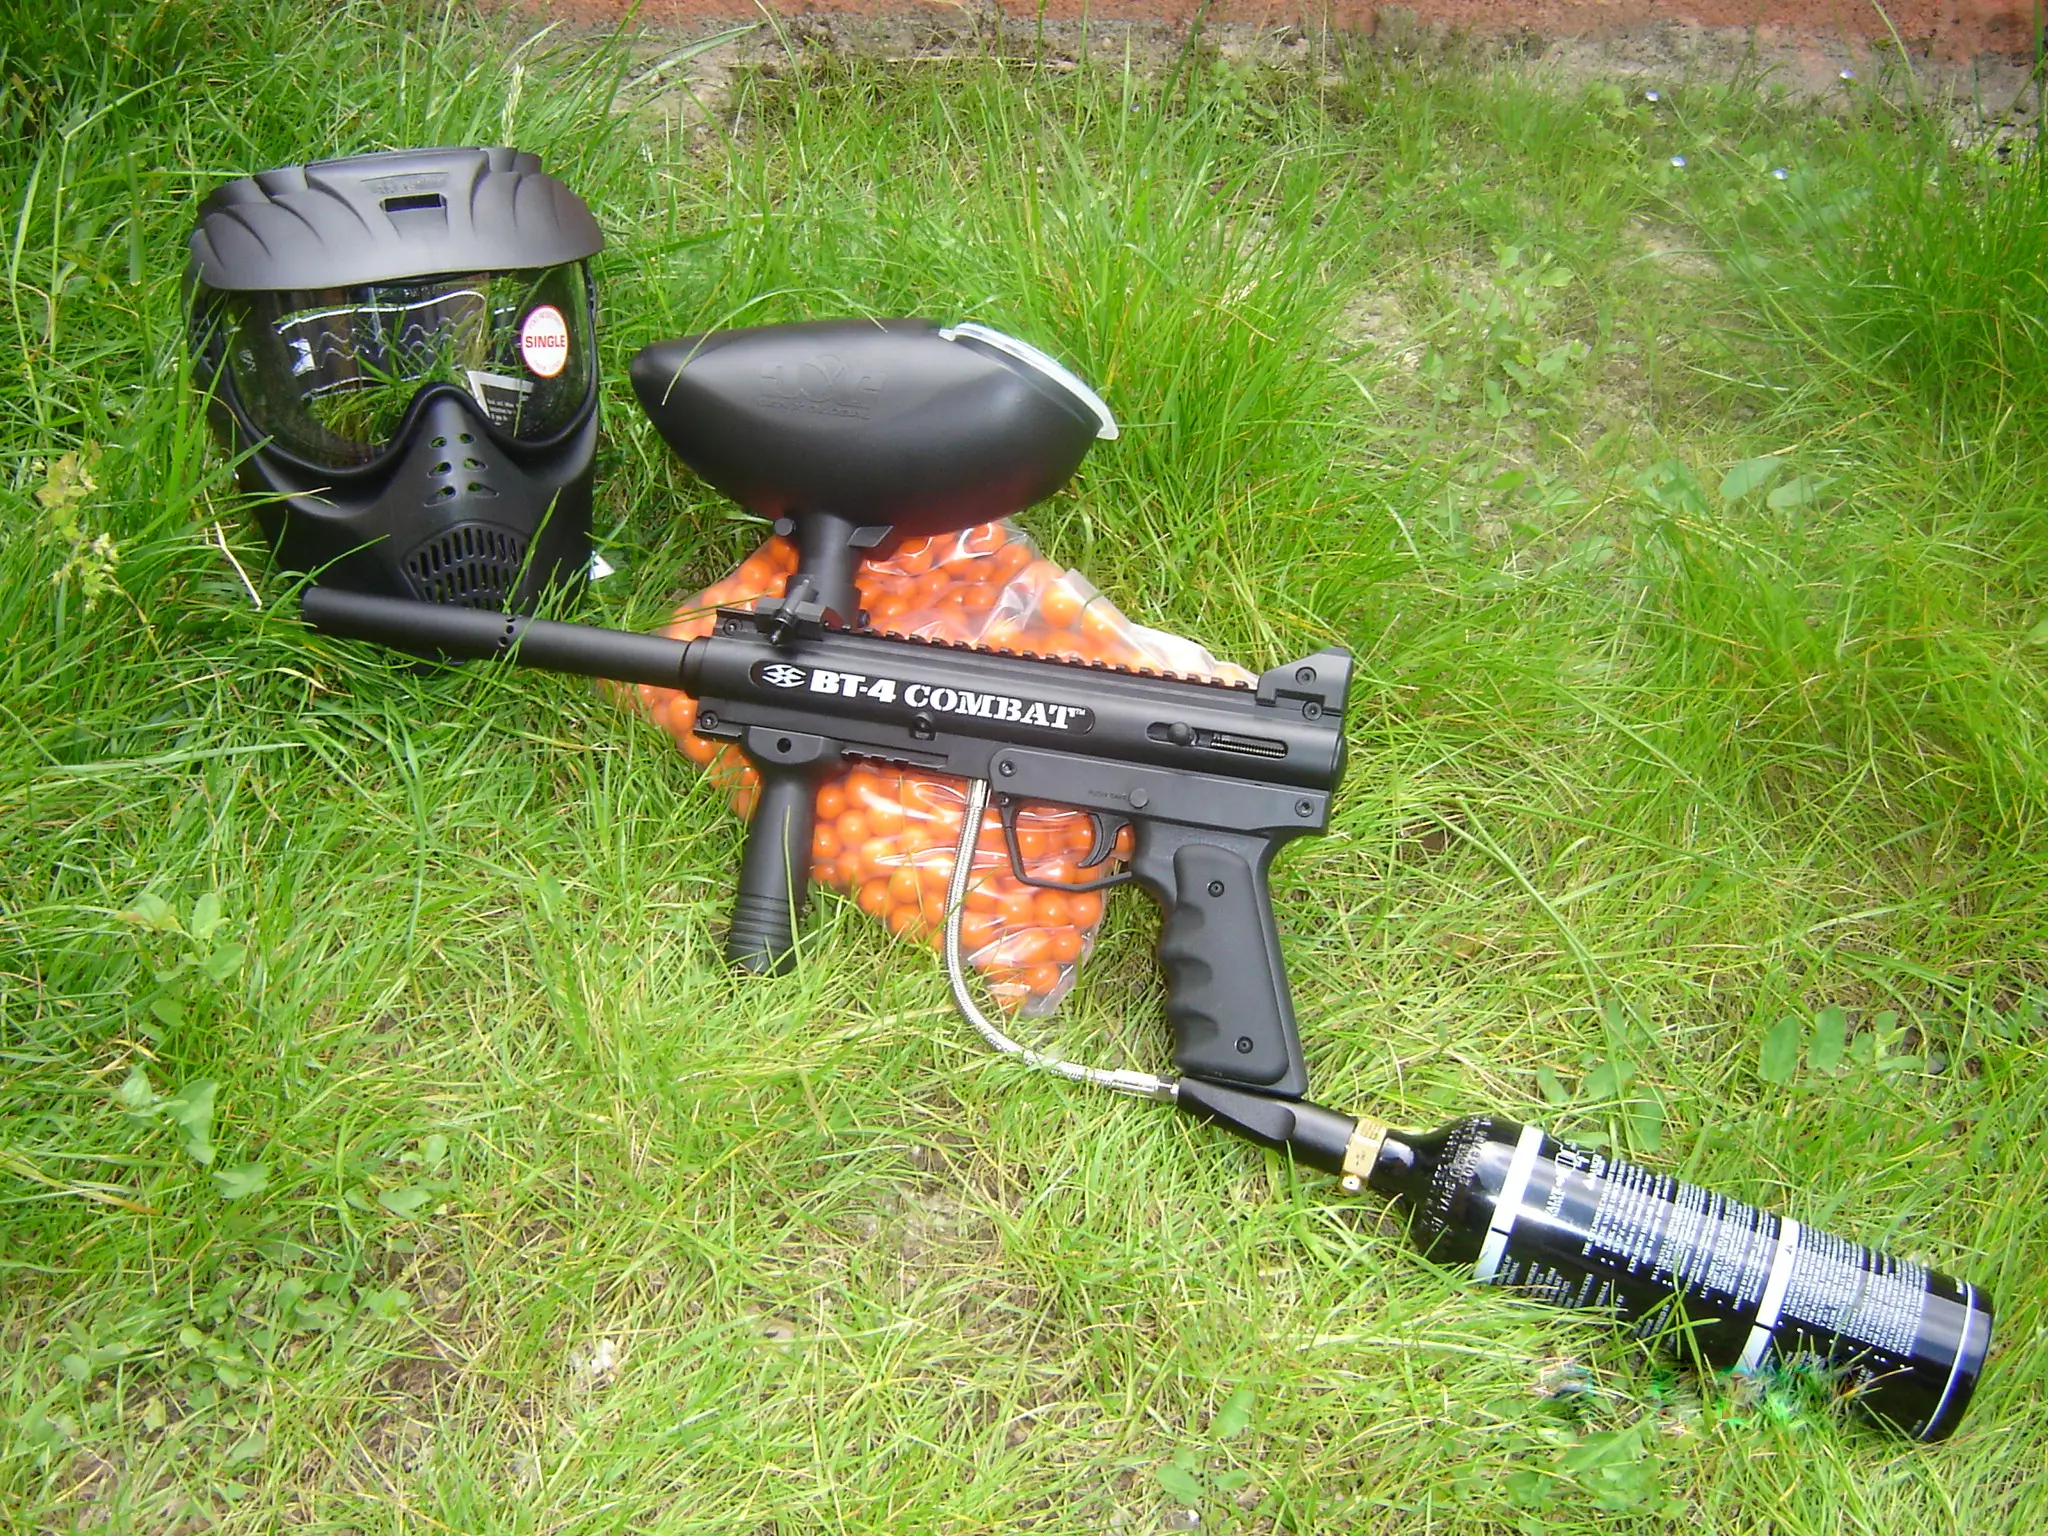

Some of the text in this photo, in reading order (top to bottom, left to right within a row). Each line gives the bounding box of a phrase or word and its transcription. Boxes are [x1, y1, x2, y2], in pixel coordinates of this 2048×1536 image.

[525, 335, 566, 348] SINGLE
[810, 669, 1077, 729] BT-4 COMBAT
[1581, 1241, 1592, 1256] THE
[1626, 1232, 1646, 1272] EXPLOSION
